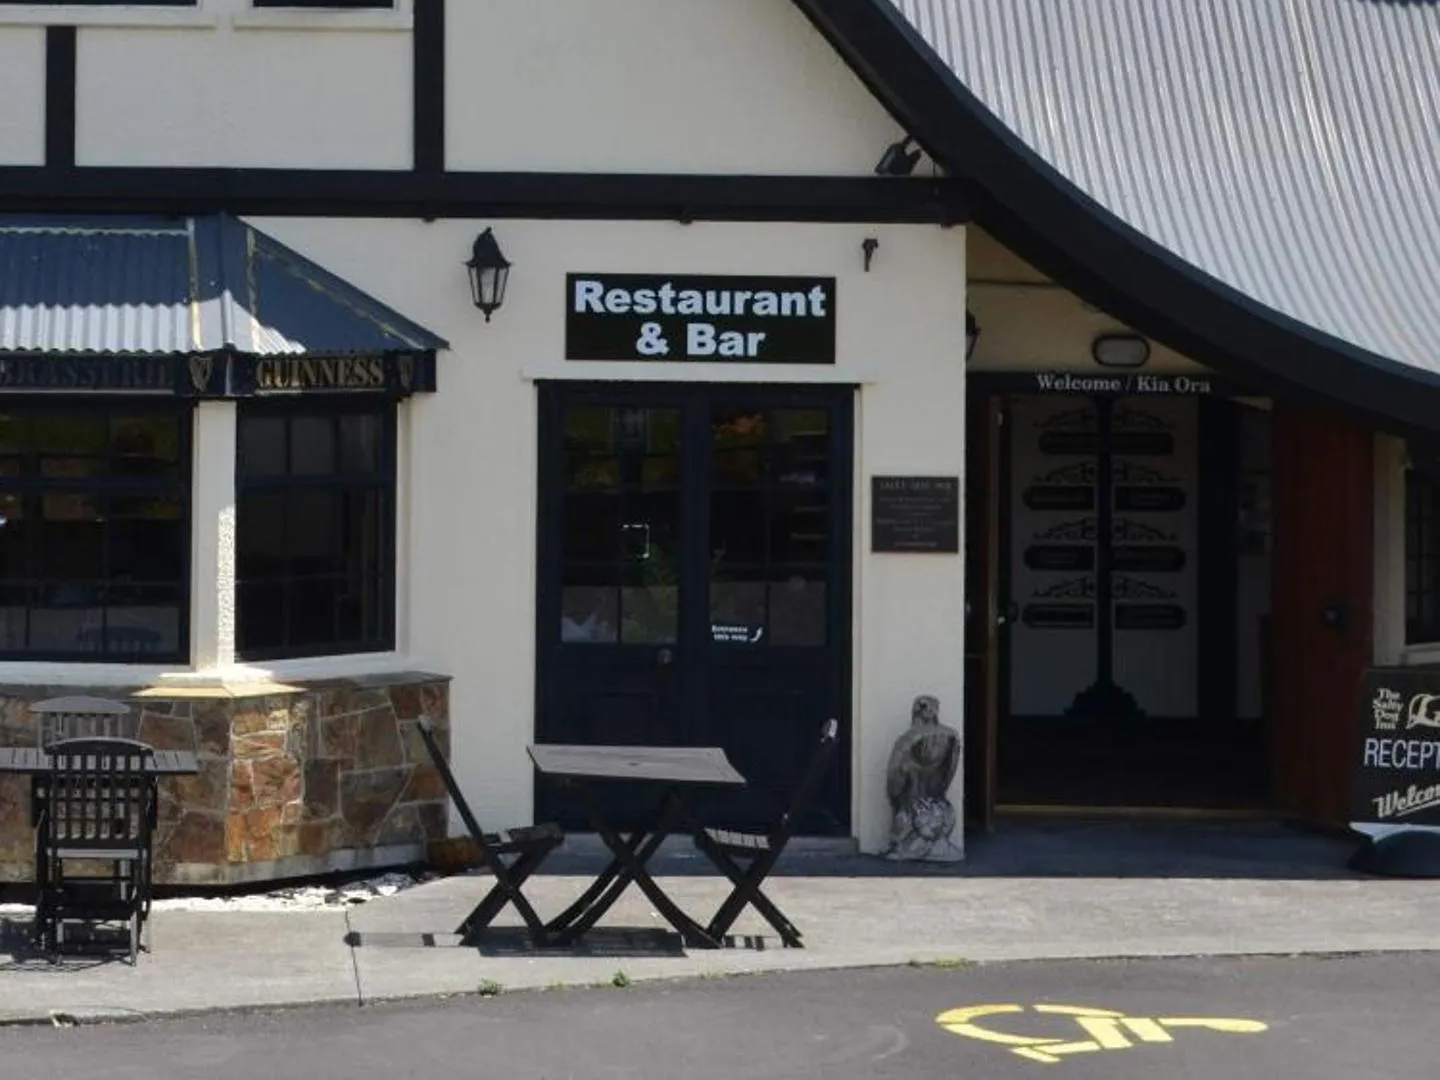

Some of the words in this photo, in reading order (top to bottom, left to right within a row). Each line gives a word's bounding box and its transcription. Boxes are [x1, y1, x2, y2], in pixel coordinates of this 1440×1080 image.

[574, 281, 826, 317] Restaurant
[635, 322, 670, 356] &
[687, 323, 766, 357] Bar
[256, 357, 384, 388] GUINNESS
[1036, 373, 1121, 391] Welcome
[1137, 376, 1169, 392] Kia
[1174, 376, 1211, 393] Ora
[1377, 687, 1400, 699] The
